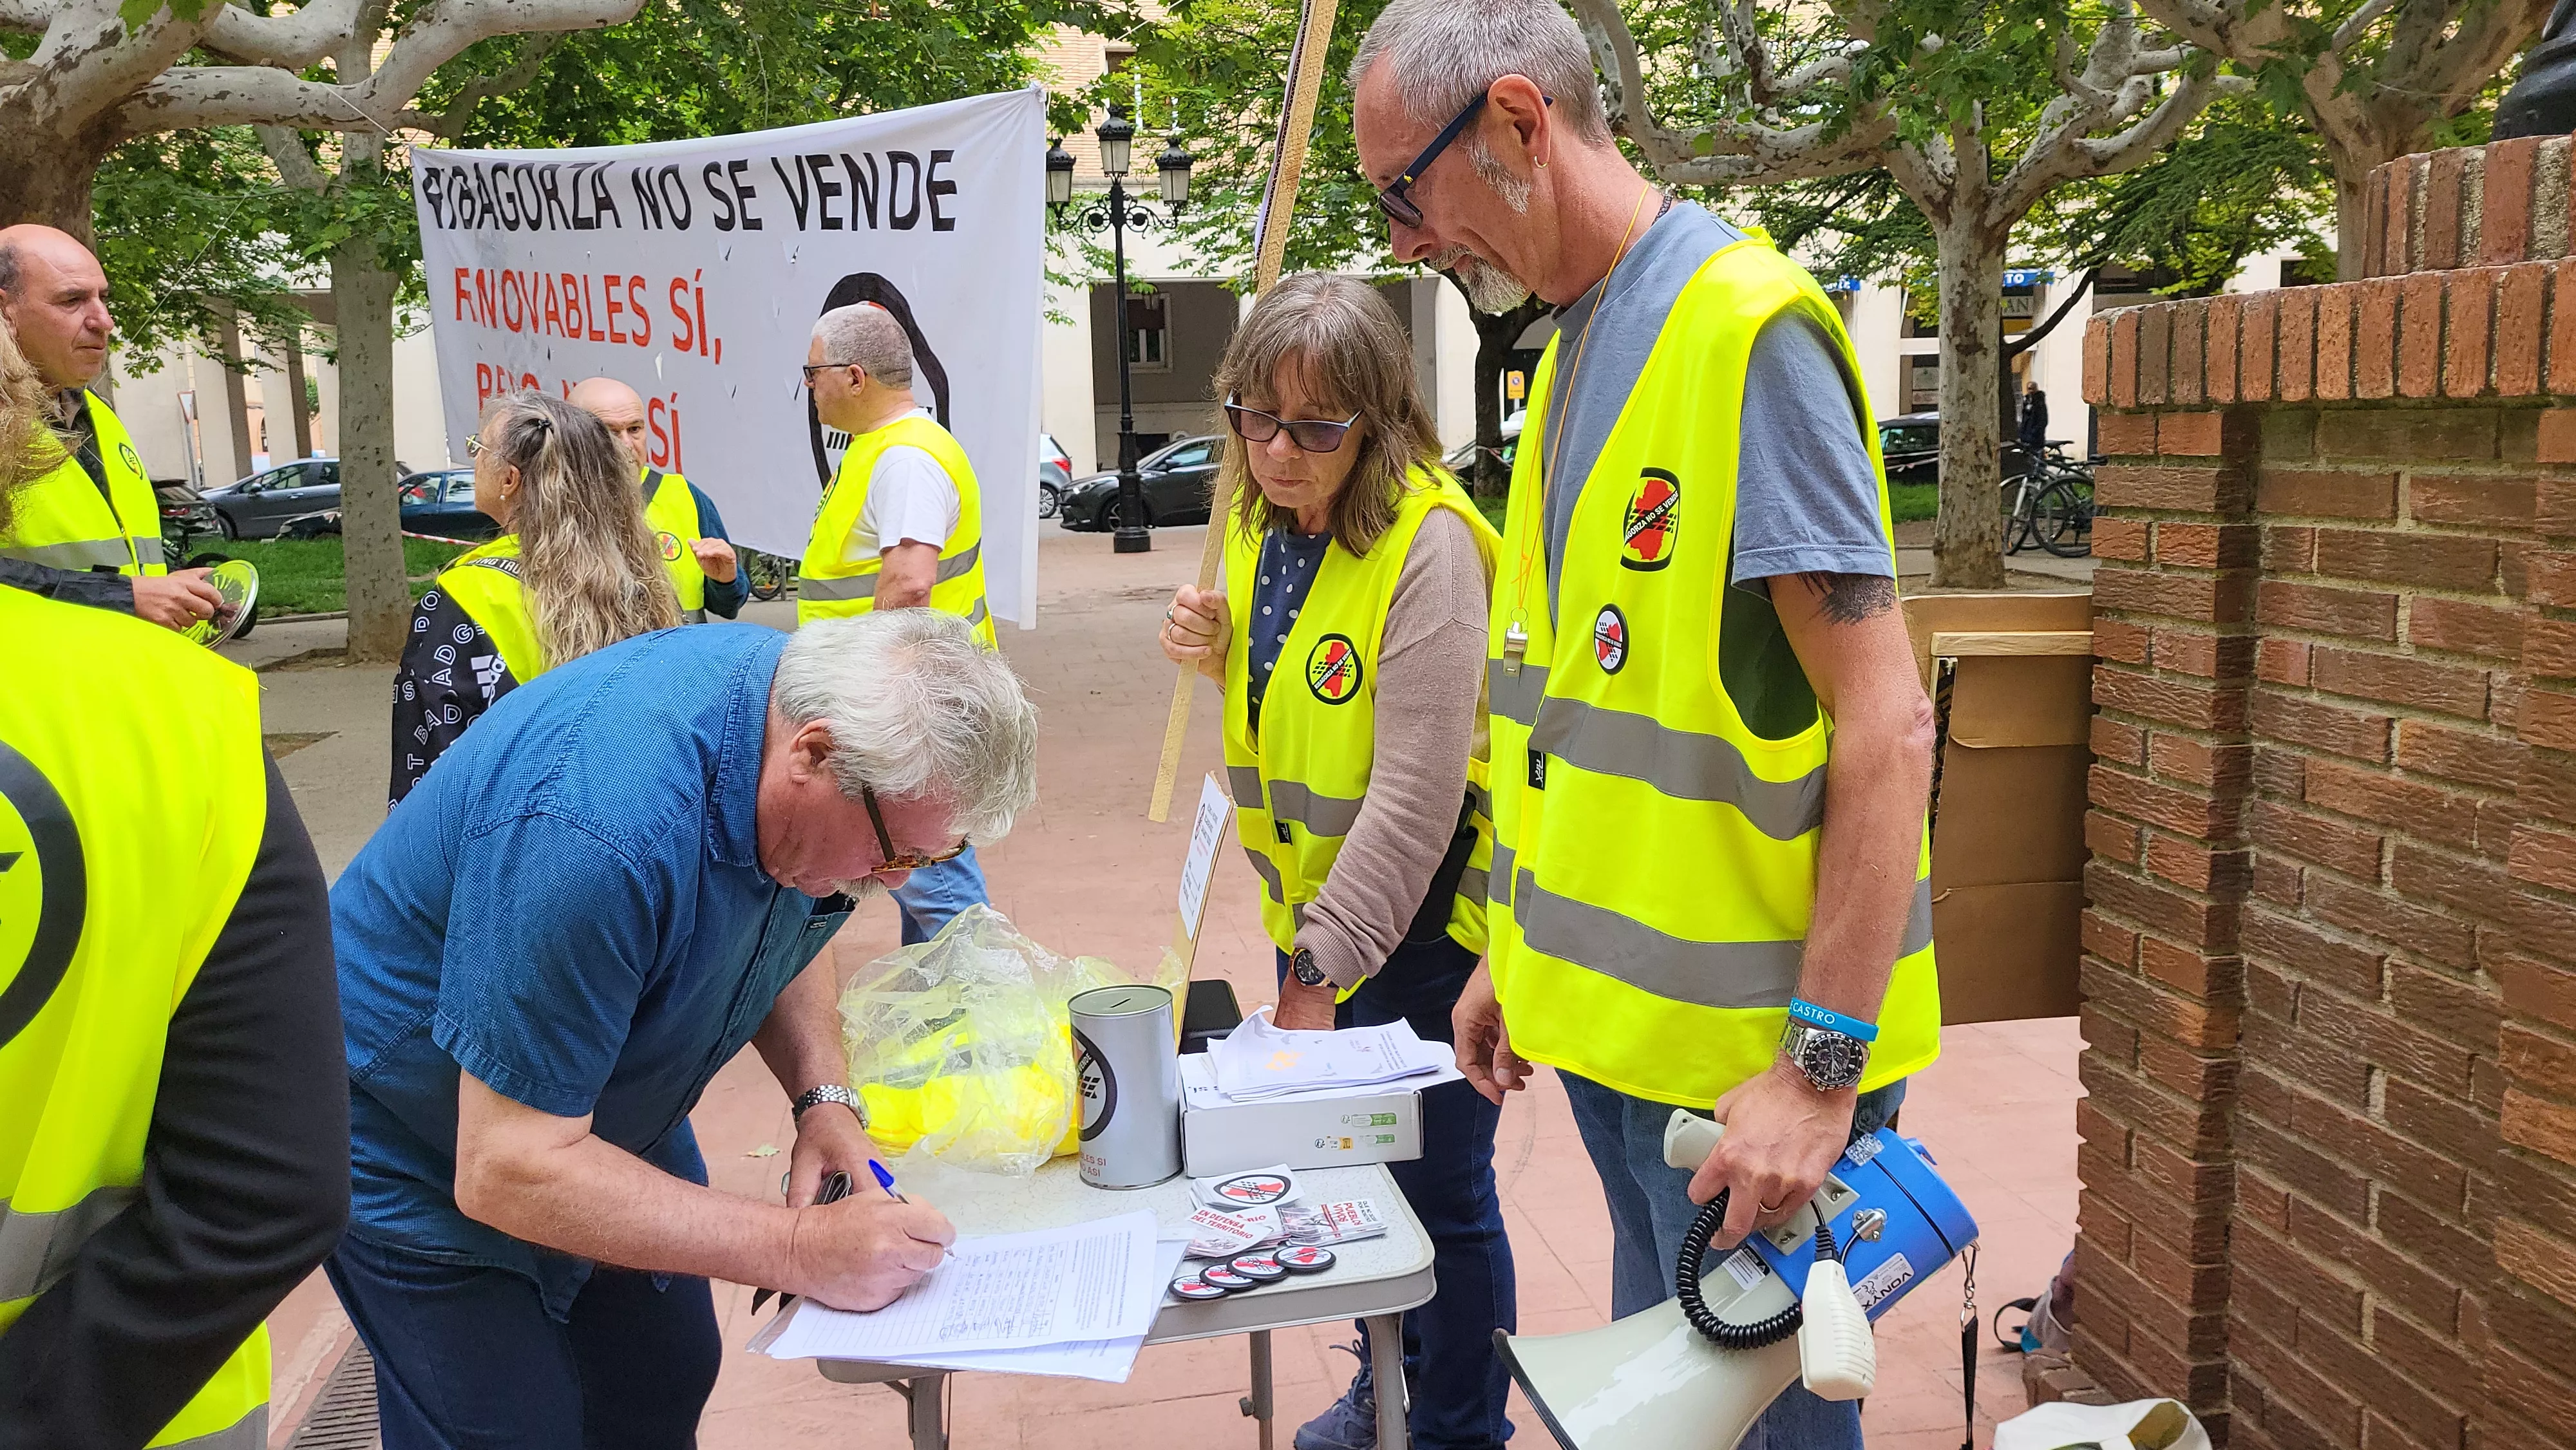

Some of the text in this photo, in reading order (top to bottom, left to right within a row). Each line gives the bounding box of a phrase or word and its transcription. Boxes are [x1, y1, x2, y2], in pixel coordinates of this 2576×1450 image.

[632, 164, 692, 231] NO
[703, 158, 762, 232] SE
[771, 149, 958, 231] VENDE
[647, 391, 683, 475] SÍ
[1646, 513, 1656, 523] NO
[1654, 505, 1665, 516] SE
[1663, 490, 1679, 508] VENDE
[1206, 1219, 1253, 1239] TERRITORIO
[1208, 1213, 1245, 1229] DEFENSA
[1861, 1272, 1912, 1311] VONYX
